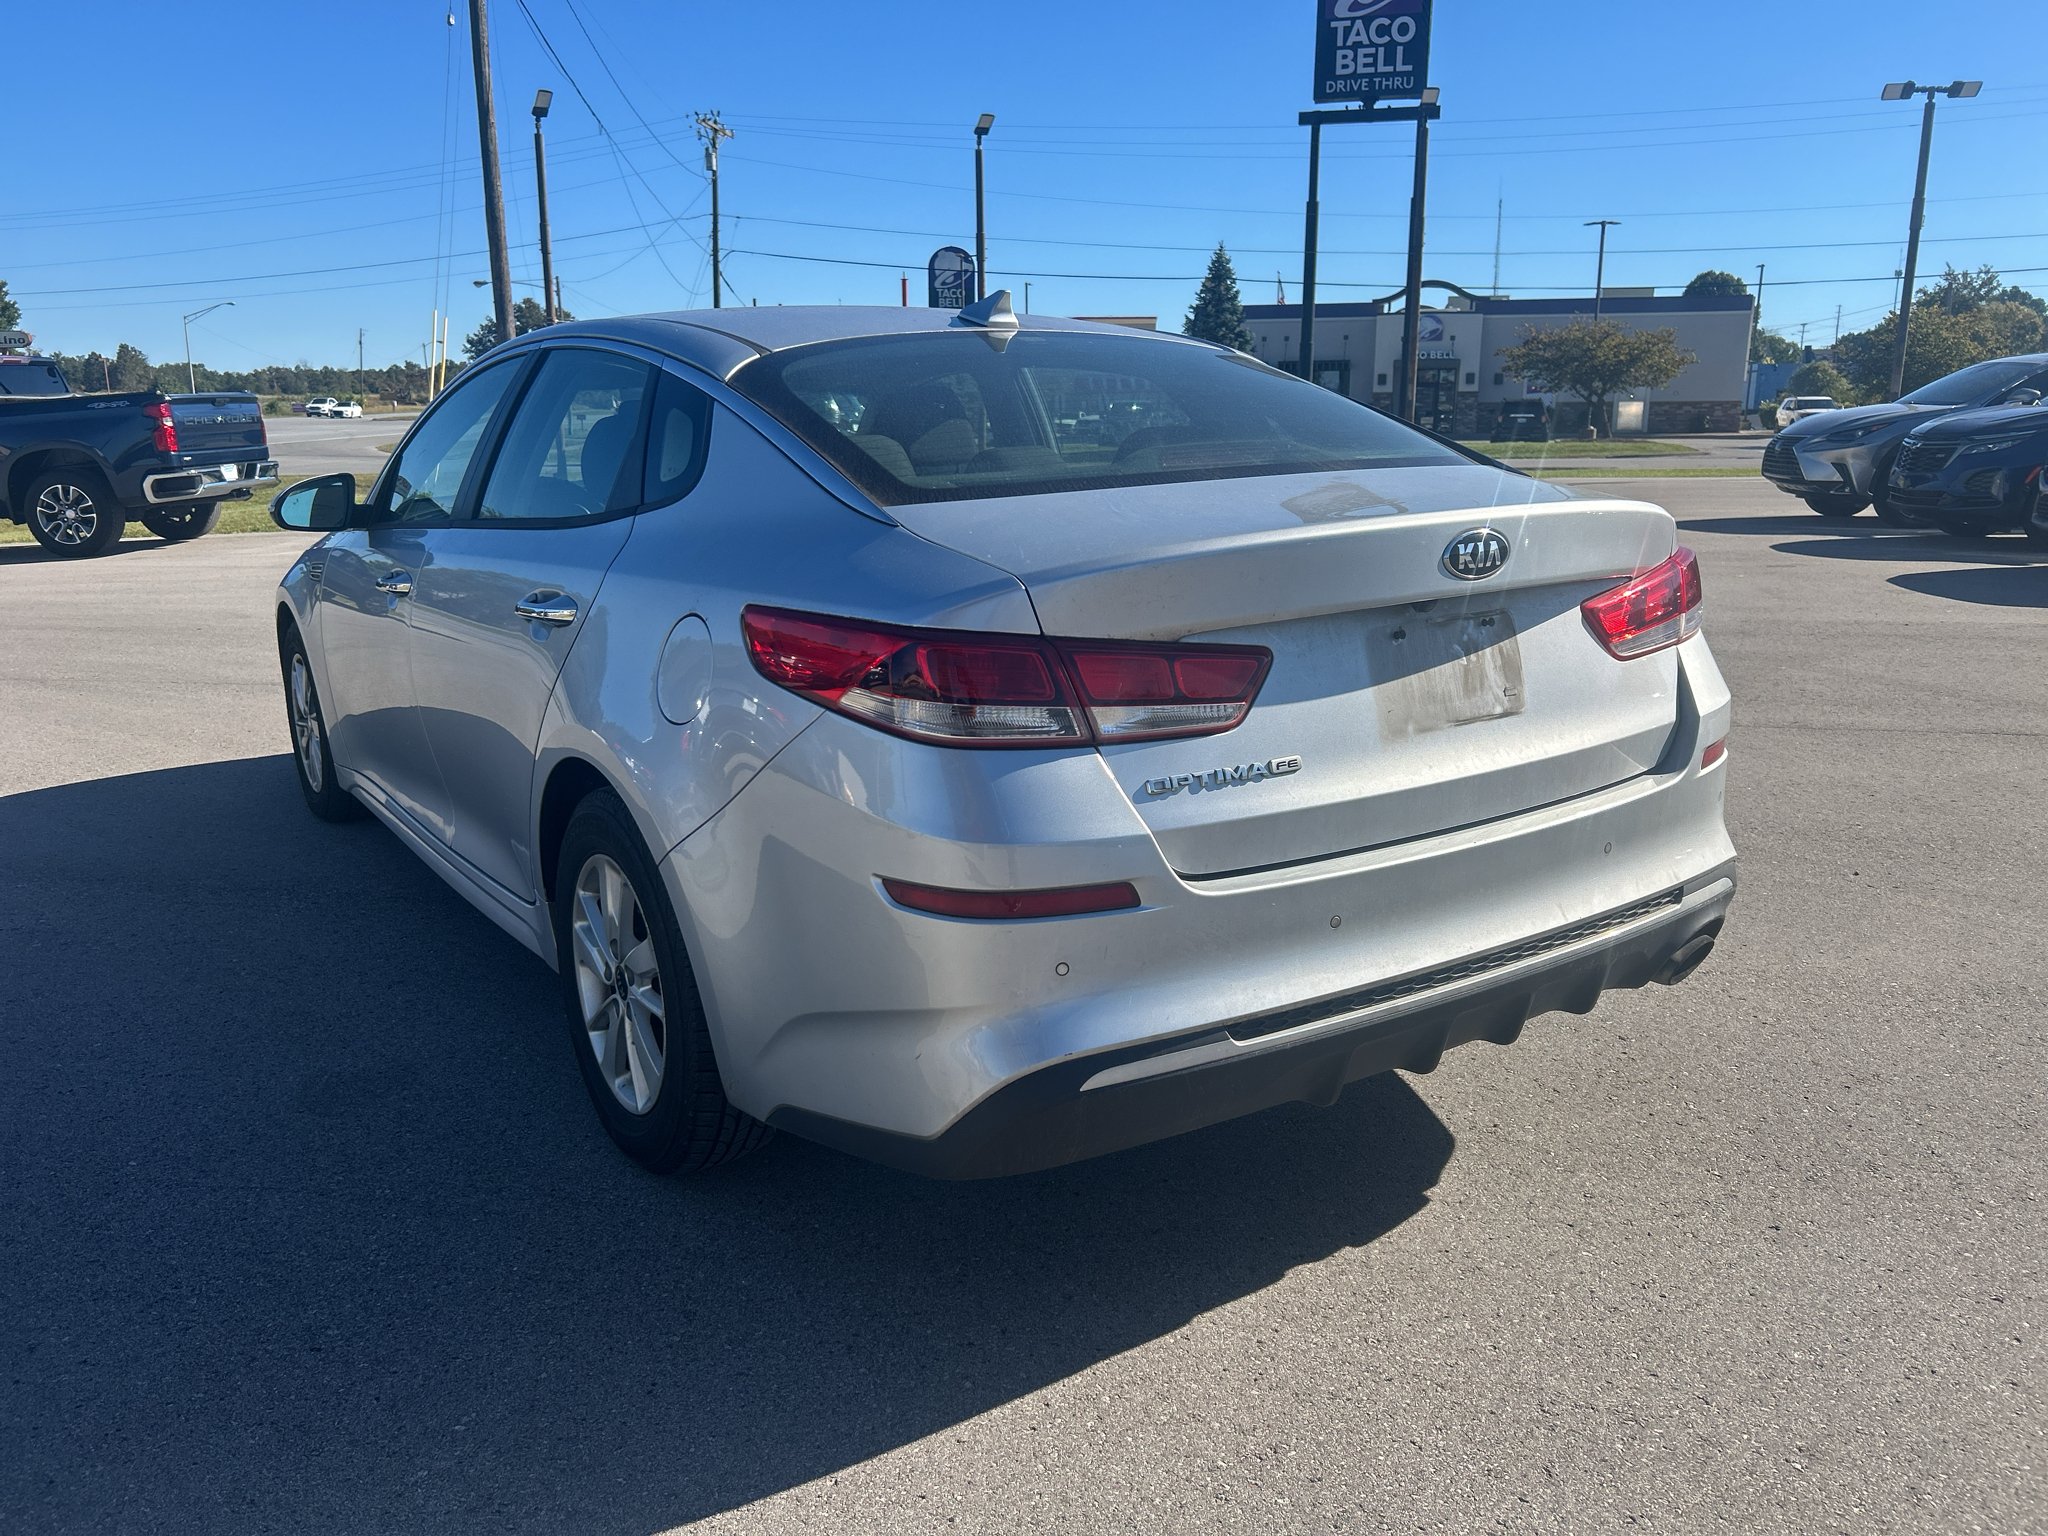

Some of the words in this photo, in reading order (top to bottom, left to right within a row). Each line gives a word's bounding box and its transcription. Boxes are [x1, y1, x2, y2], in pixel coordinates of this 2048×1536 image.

[1330, 15, 1416, 47] TACO
[1335, 45, 1413, 76] BELL
[1325, 78, 1369, 93] DRIVE
[1373, 76, 1414, 90] THRU
[936, 288, 966, 298] TACO
[1430, 350, 1455, 359] BELL
[184, 414, 259, 425] CHEVROLET
[1457, 540, 1501, 570] KIA
[1145, 761, 1270, 796] OPTIMA
[1276, 759, 1299, 771] FE
